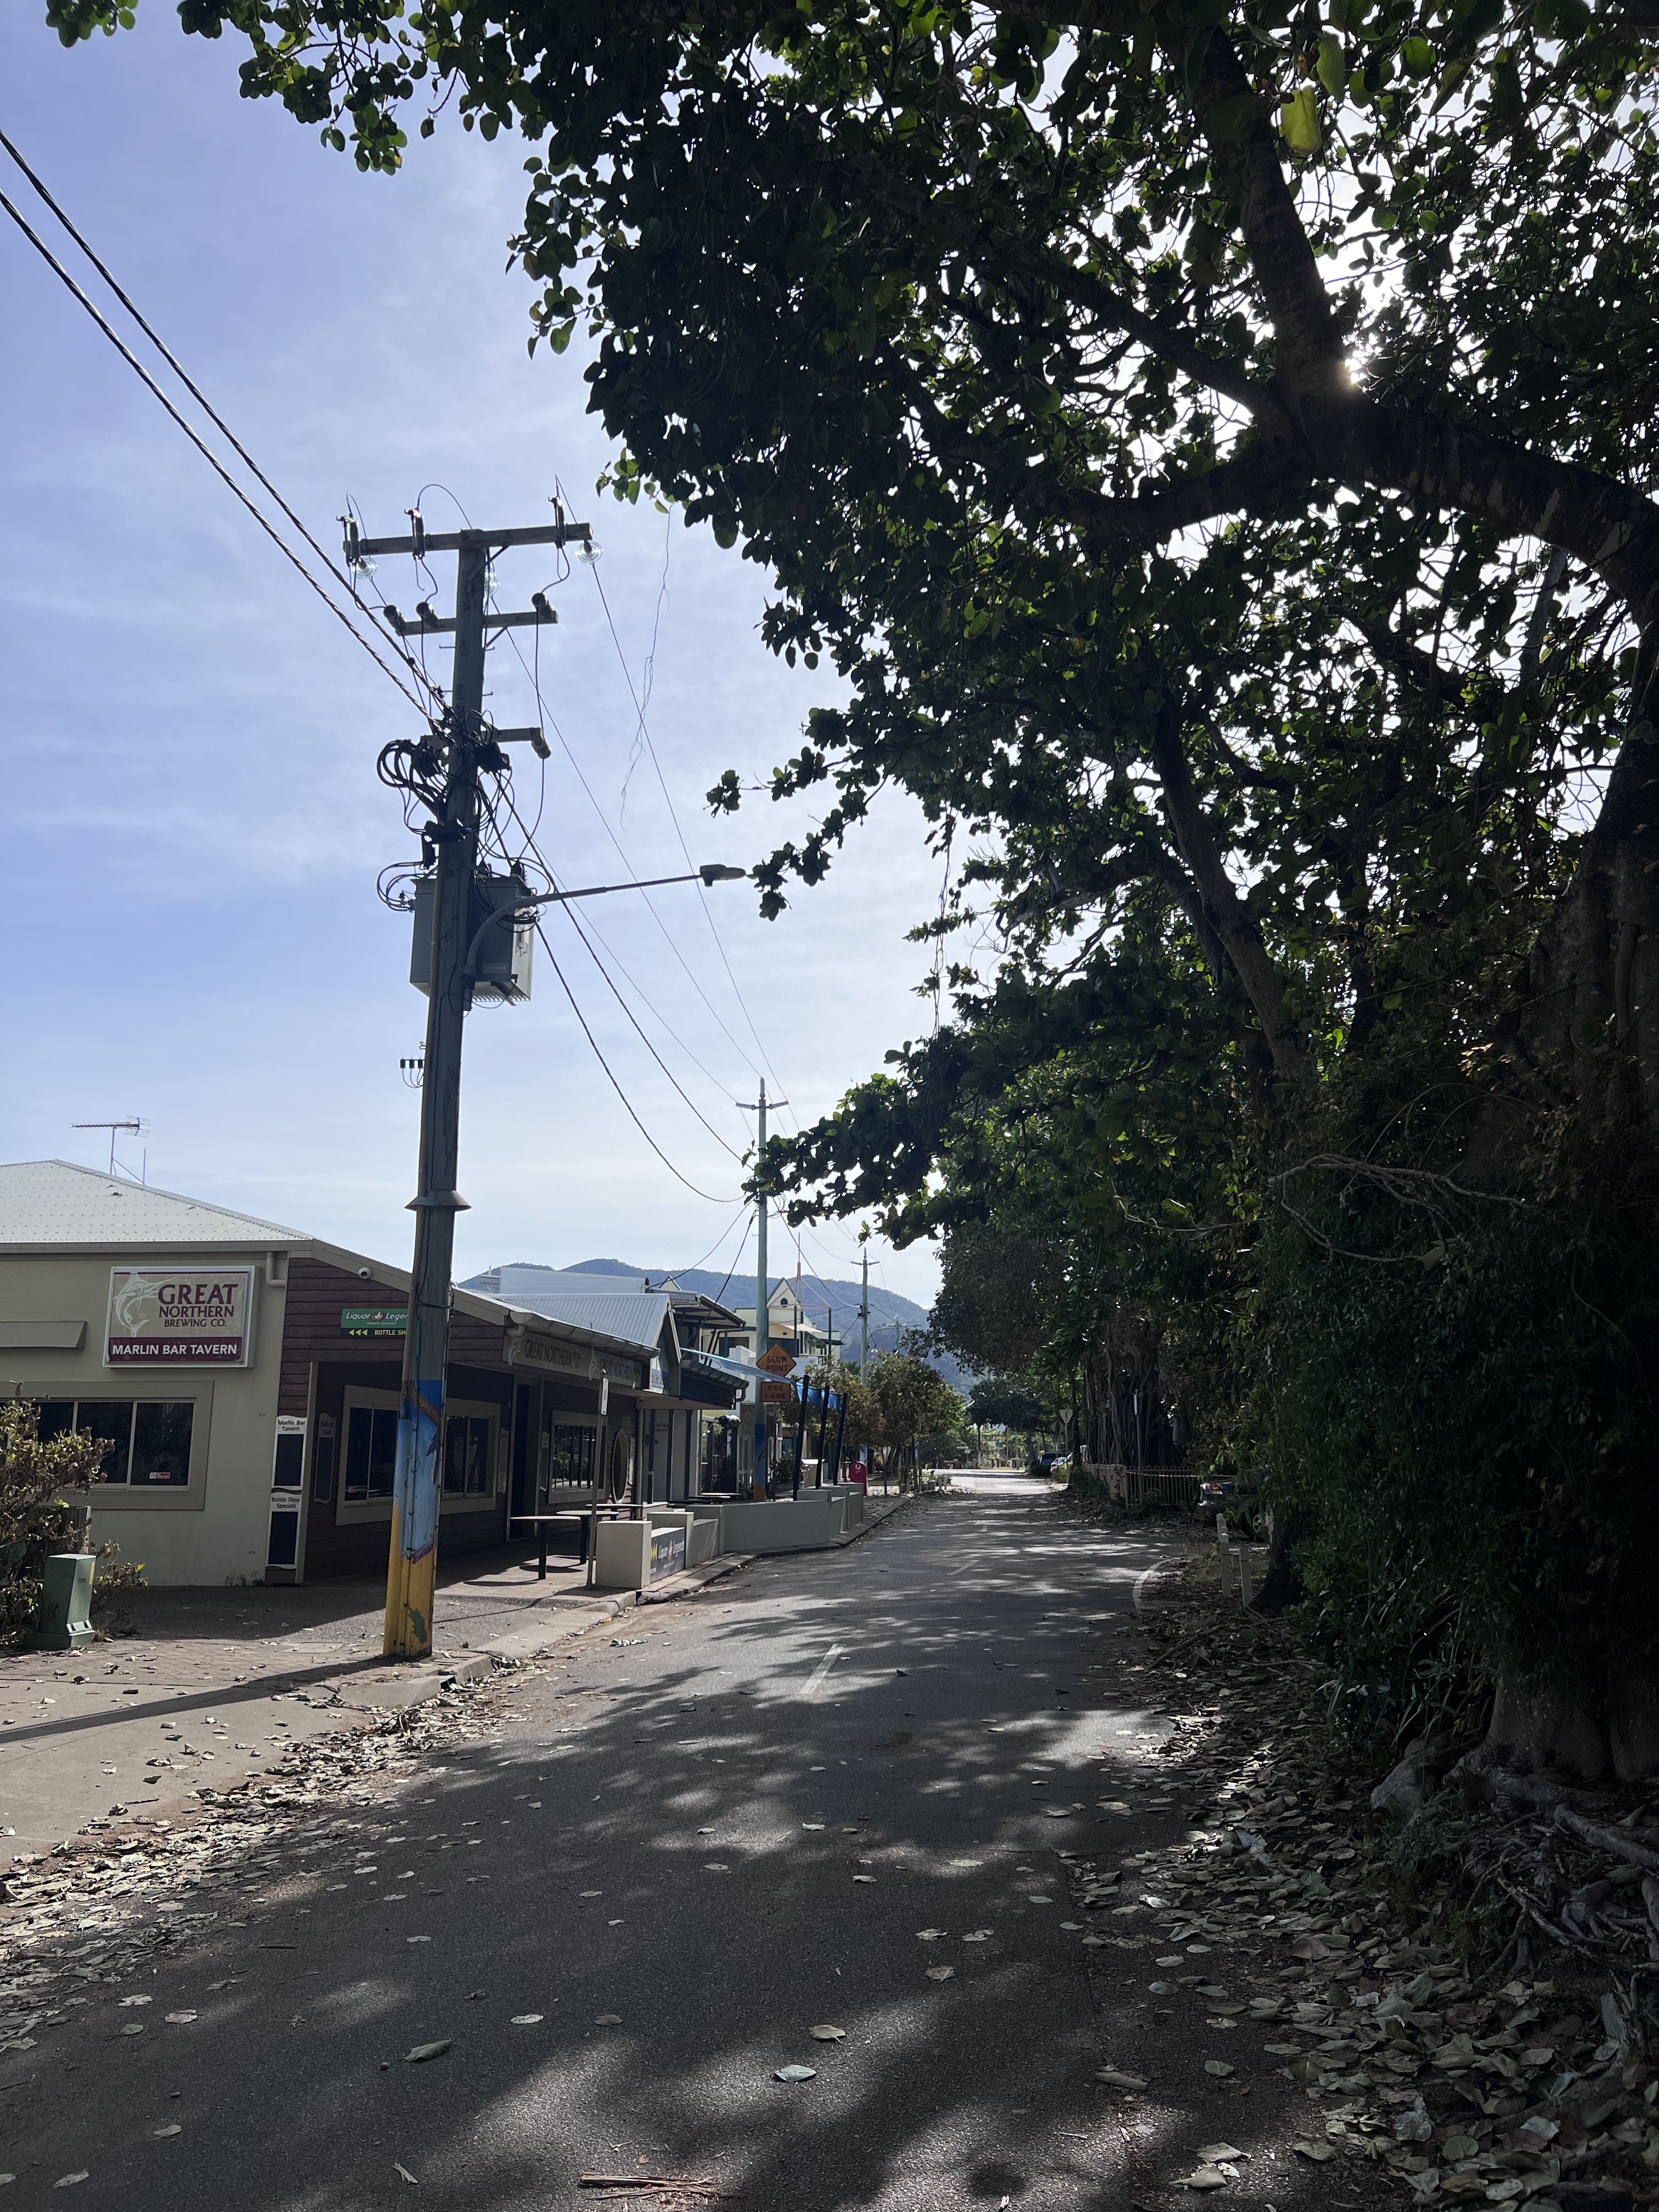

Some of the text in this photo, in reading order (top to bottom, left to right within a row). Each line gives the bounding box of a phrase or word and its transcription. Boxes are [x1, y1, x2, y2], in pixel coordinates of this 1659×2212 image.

[157, 1284, 239, 1305] GREAT
[159, 1306, 234, 1318] NORTHERN
[346, 1312, 371, 1321] Liquor
[164, 1319, 227, 1327] BREWING CO.
[112, 1345, 237, 1355] MARLIN BAR TAVERN
[525, 1339, 544, 1360] GREAT
[544, 1344, 572, 1367] NORTHERN
